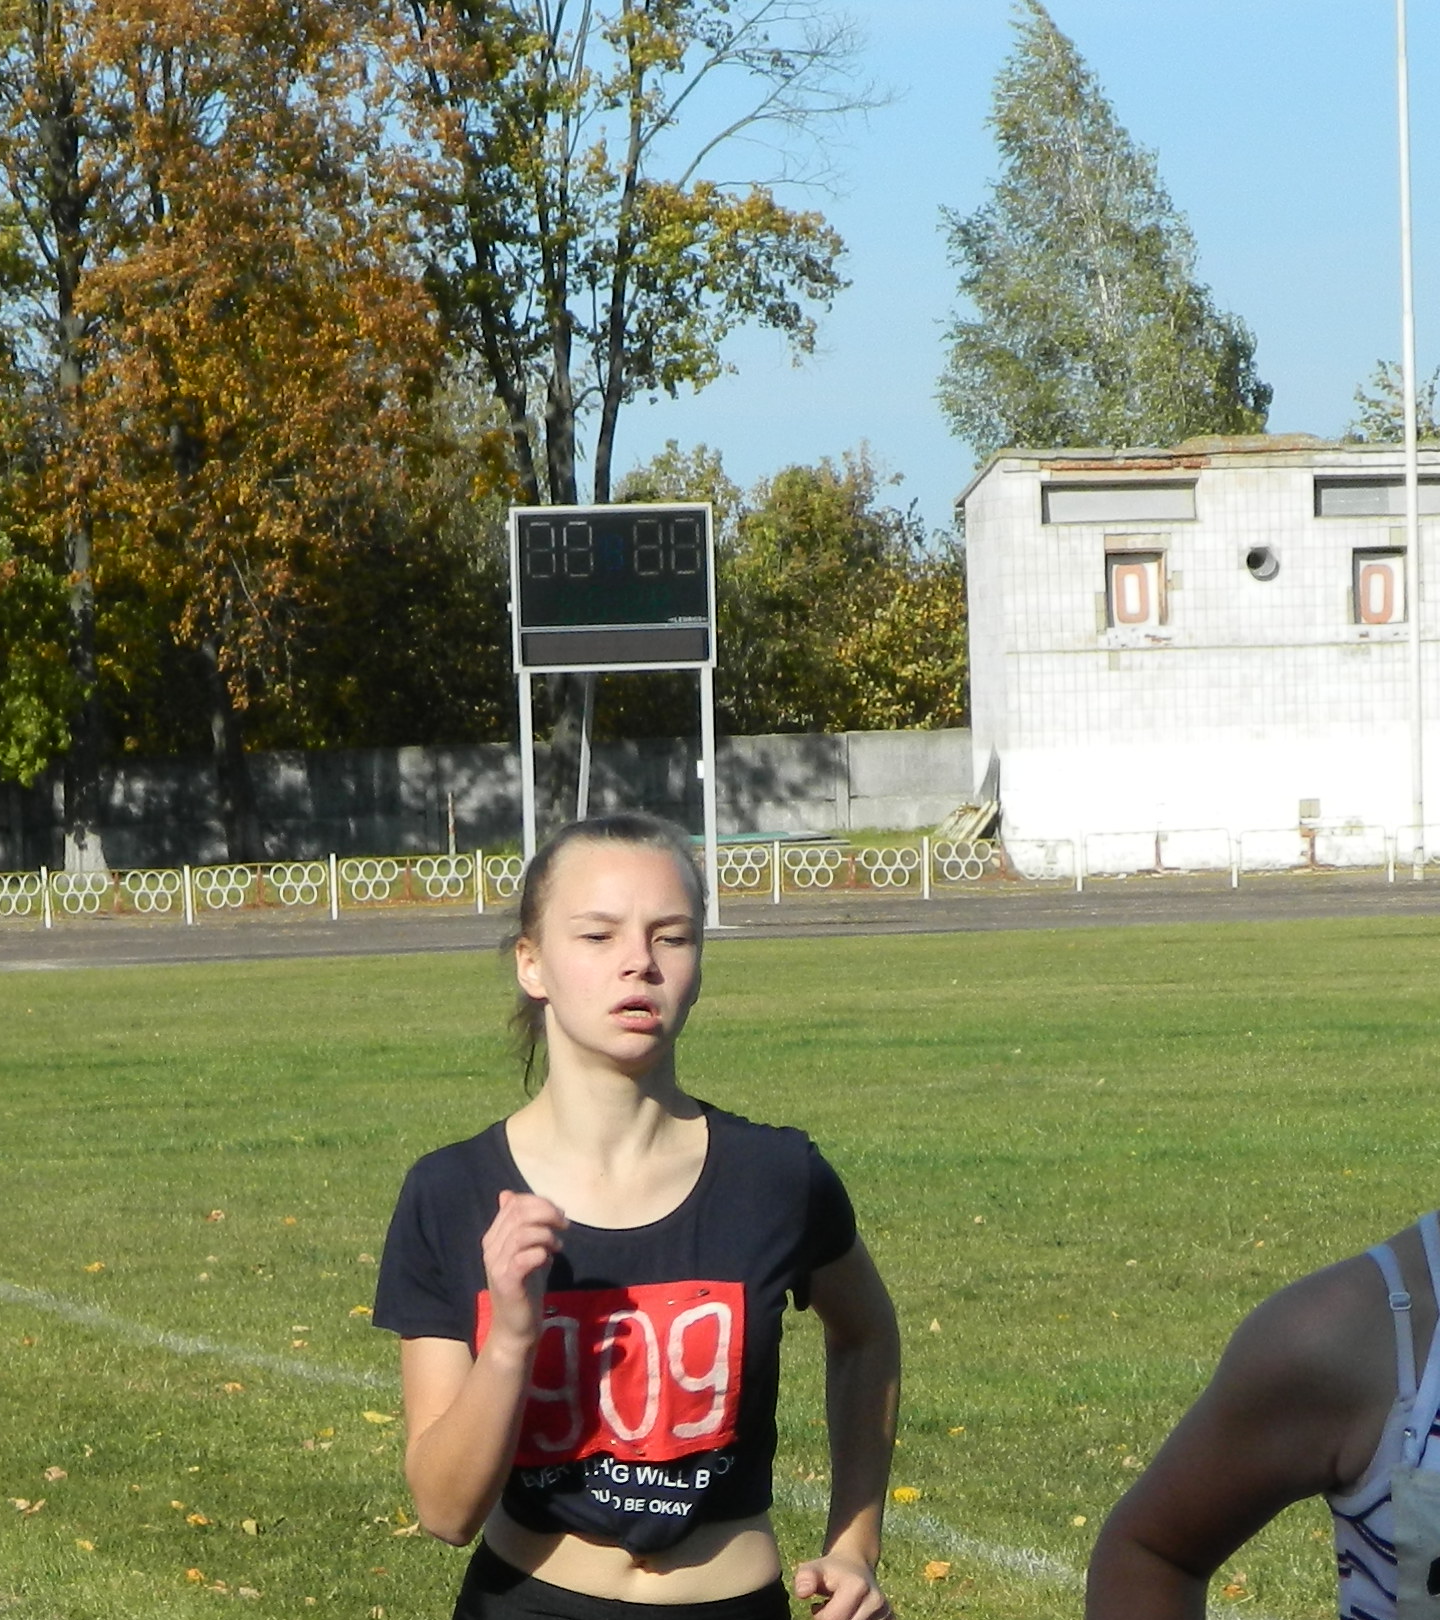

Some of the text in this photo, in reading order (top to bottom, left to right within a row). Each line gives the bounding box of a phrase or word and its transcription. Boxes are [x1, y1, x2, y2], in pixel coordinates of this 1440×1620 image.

[526, 1301, 733, 1452] 909
[623, 1498, 646, 1512] BE
[648, 1500, 693, 1517] OKAY
